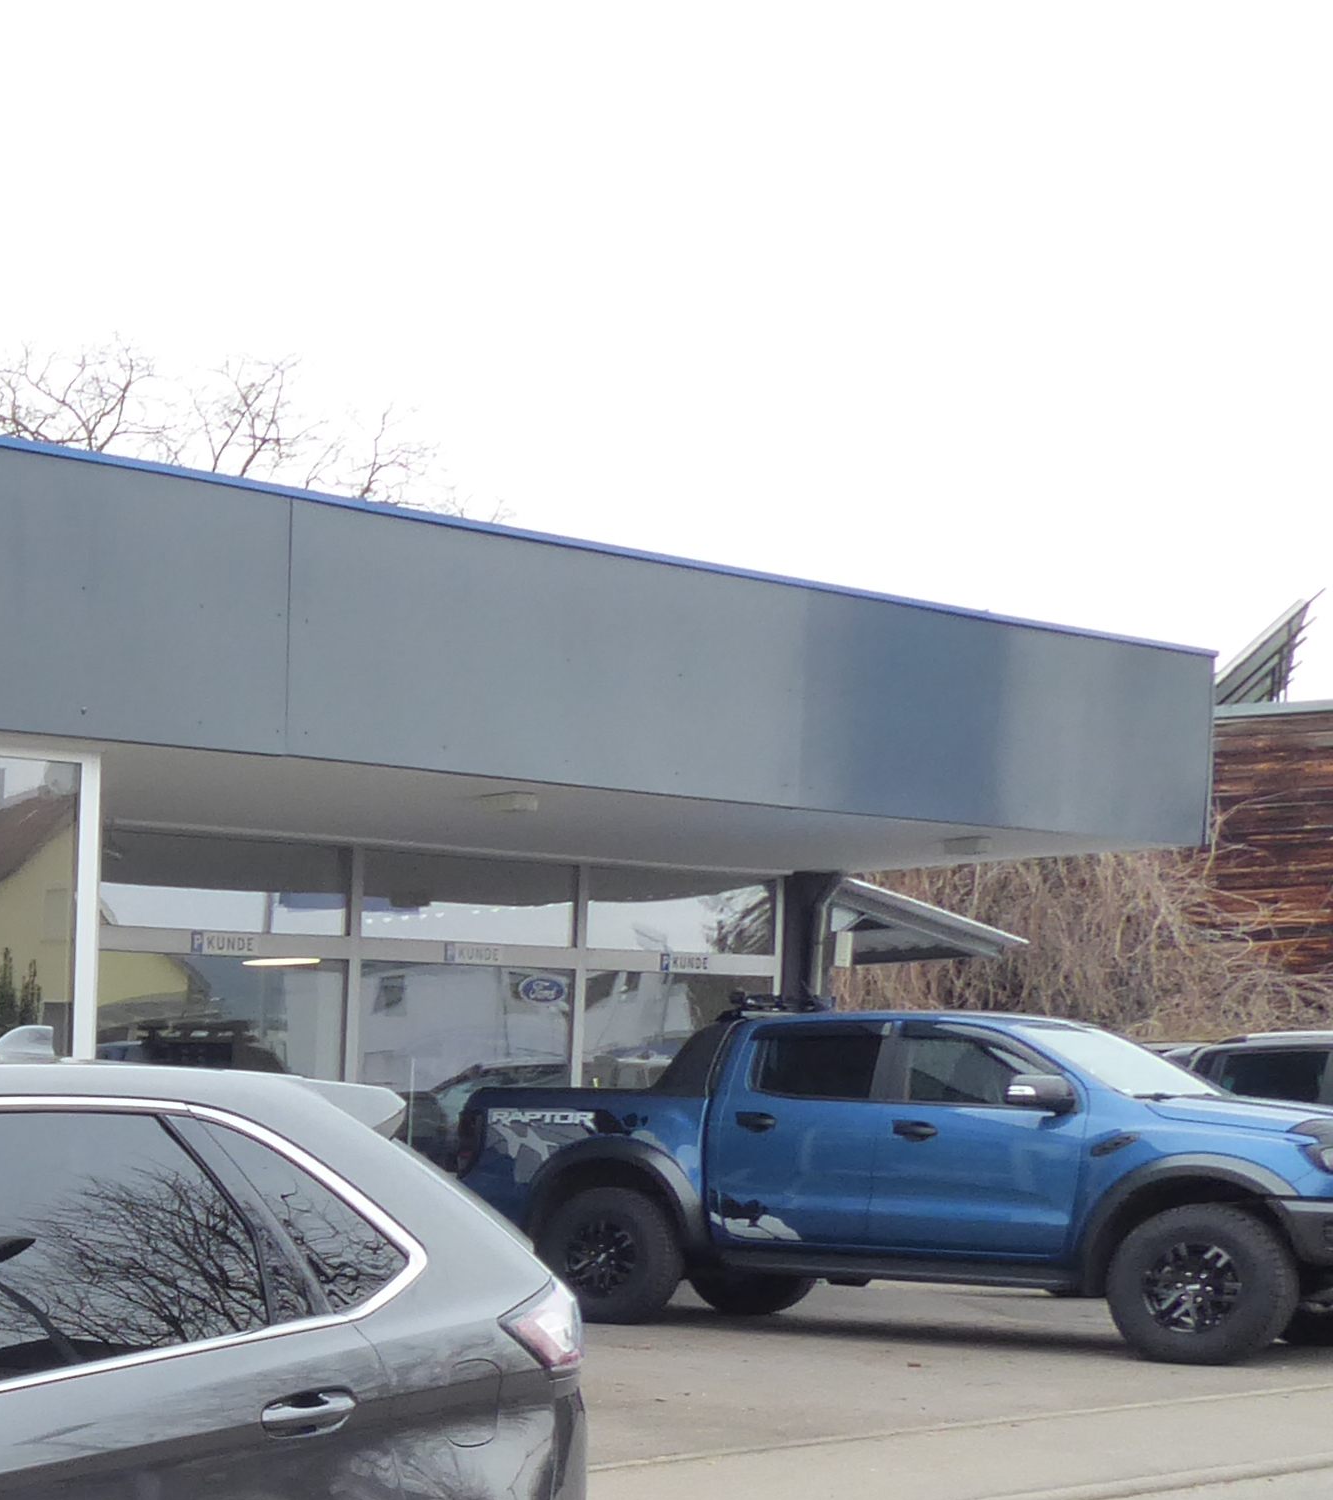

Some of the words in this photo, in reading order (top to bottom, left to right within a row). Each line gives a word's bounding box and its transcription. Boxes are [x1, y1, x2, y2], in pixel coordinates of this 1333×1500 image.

[206, 936, 254, 952] KUNDE
[458, 947, 499, 962] KUNDE
[673, 956, 709, 970] KUNDE
[491, 1111, 598, 1134] RAPTOR
